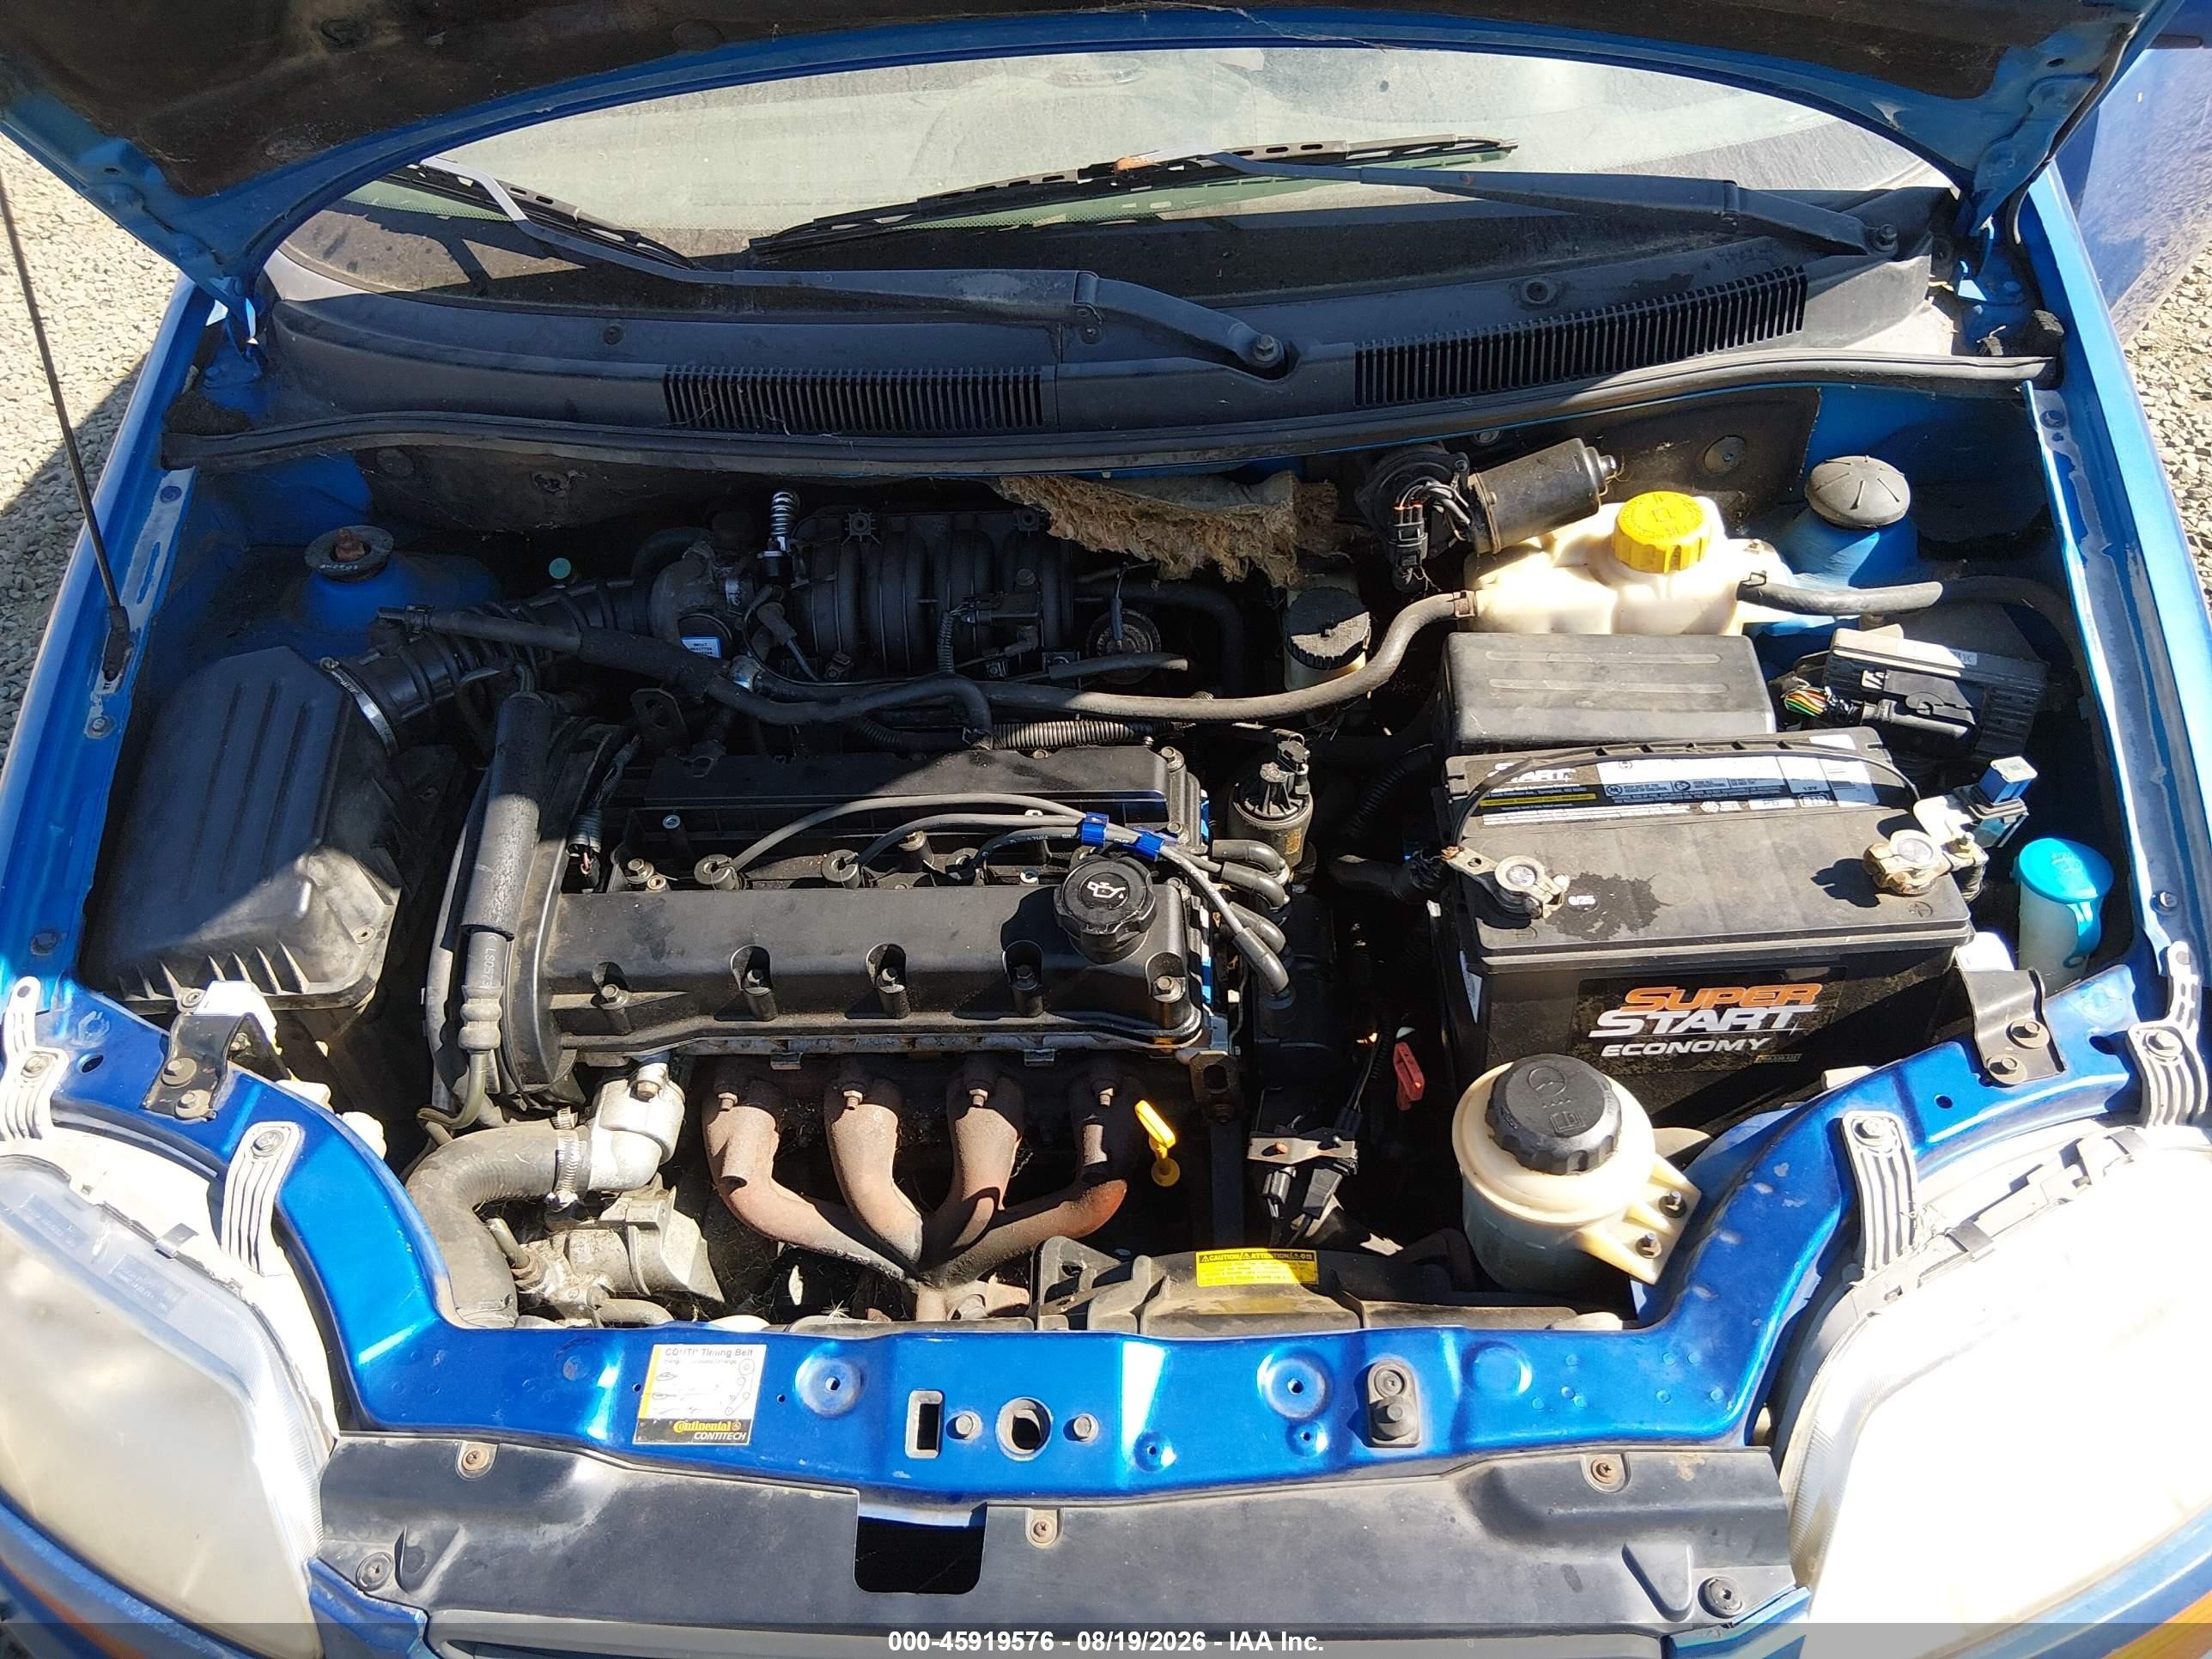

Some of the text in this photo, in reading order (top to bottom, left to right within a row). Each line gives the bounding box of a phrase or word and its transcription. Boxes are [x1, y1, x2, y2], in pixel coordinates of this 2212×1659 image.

[1620, 982, 1823, 1012] SUPER
[1588, 1004, 1817, 1038] START
[1601, 1036, 1771, 1057] ECONOMY
[734, 1348, 754, 1357] Belt
[673, 1419, 732, 1433] Continental
[693, 1431, 747, 1441] CONTITECH
